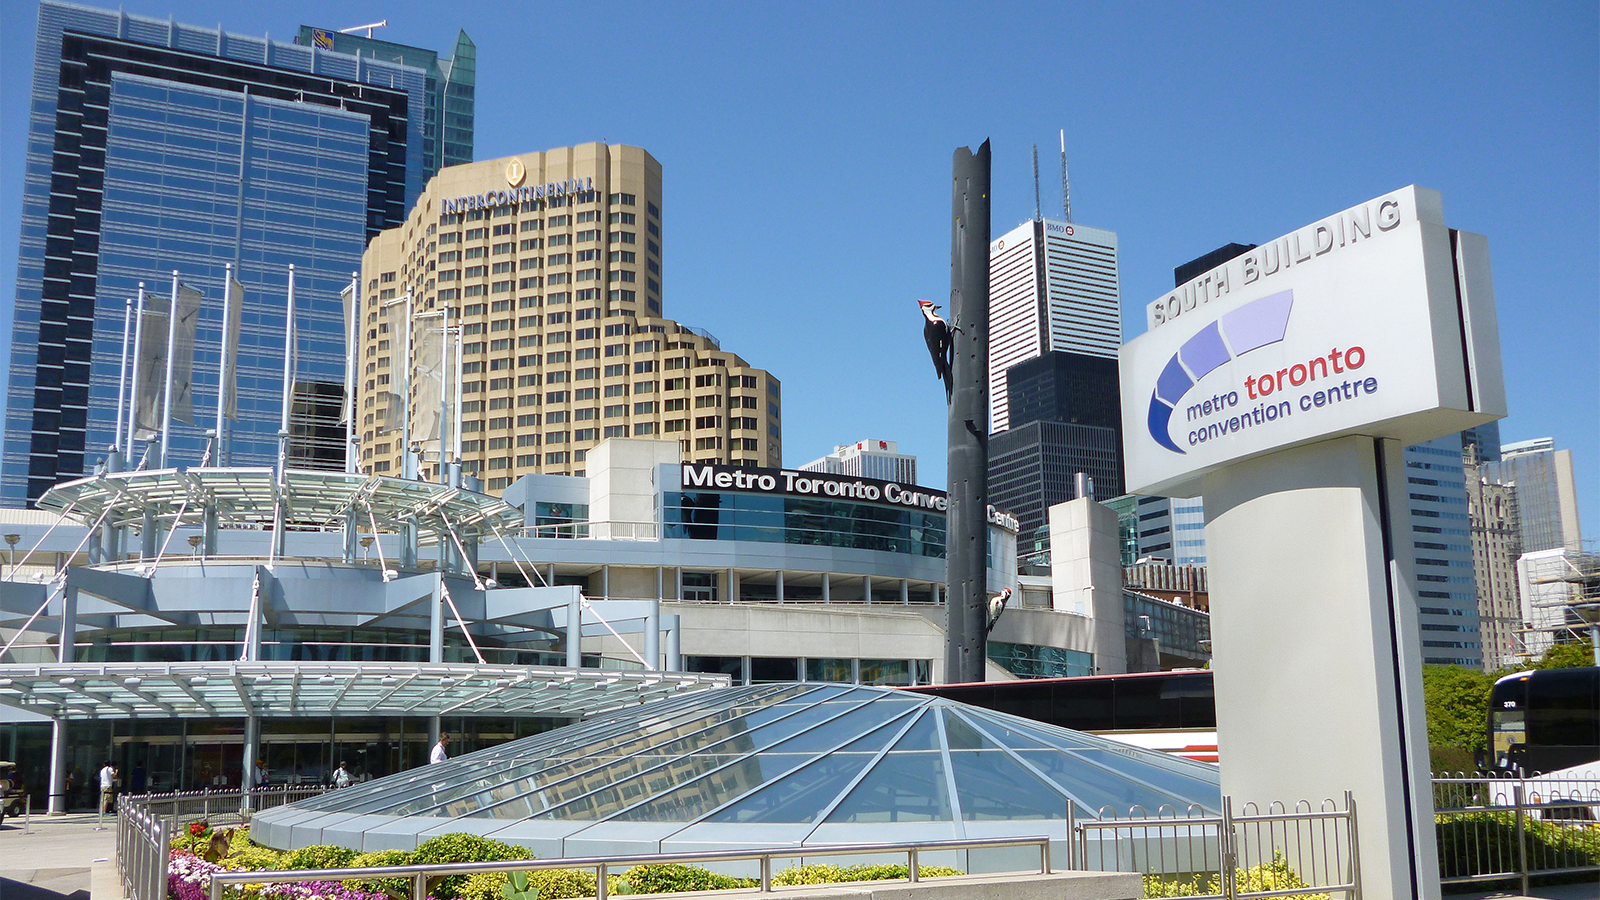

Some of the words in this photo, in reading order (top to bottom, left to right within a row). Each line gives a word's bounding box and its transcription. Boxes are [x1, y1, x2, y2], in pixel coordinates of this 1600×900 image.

[1046, 223, 1065, 234] BMO
[1153, 265, 1231, 328] SOUTH
[1242, 196, 1401, 286] BUILDING
[1186, 390, 1239, 422] metro
[1244, 346, 1366, 401] toronto
[1188, 400, 1292, 446] convention
[1299, 376, 1379, 412] centre
[683, 465, 777, 491] Metro
[780, 470, 881, 500] Toronto
[884, 482, 948, 512] Conve
[986, 504, 1020, 533] Centre
[1503, 700, 1516, 708] 370
